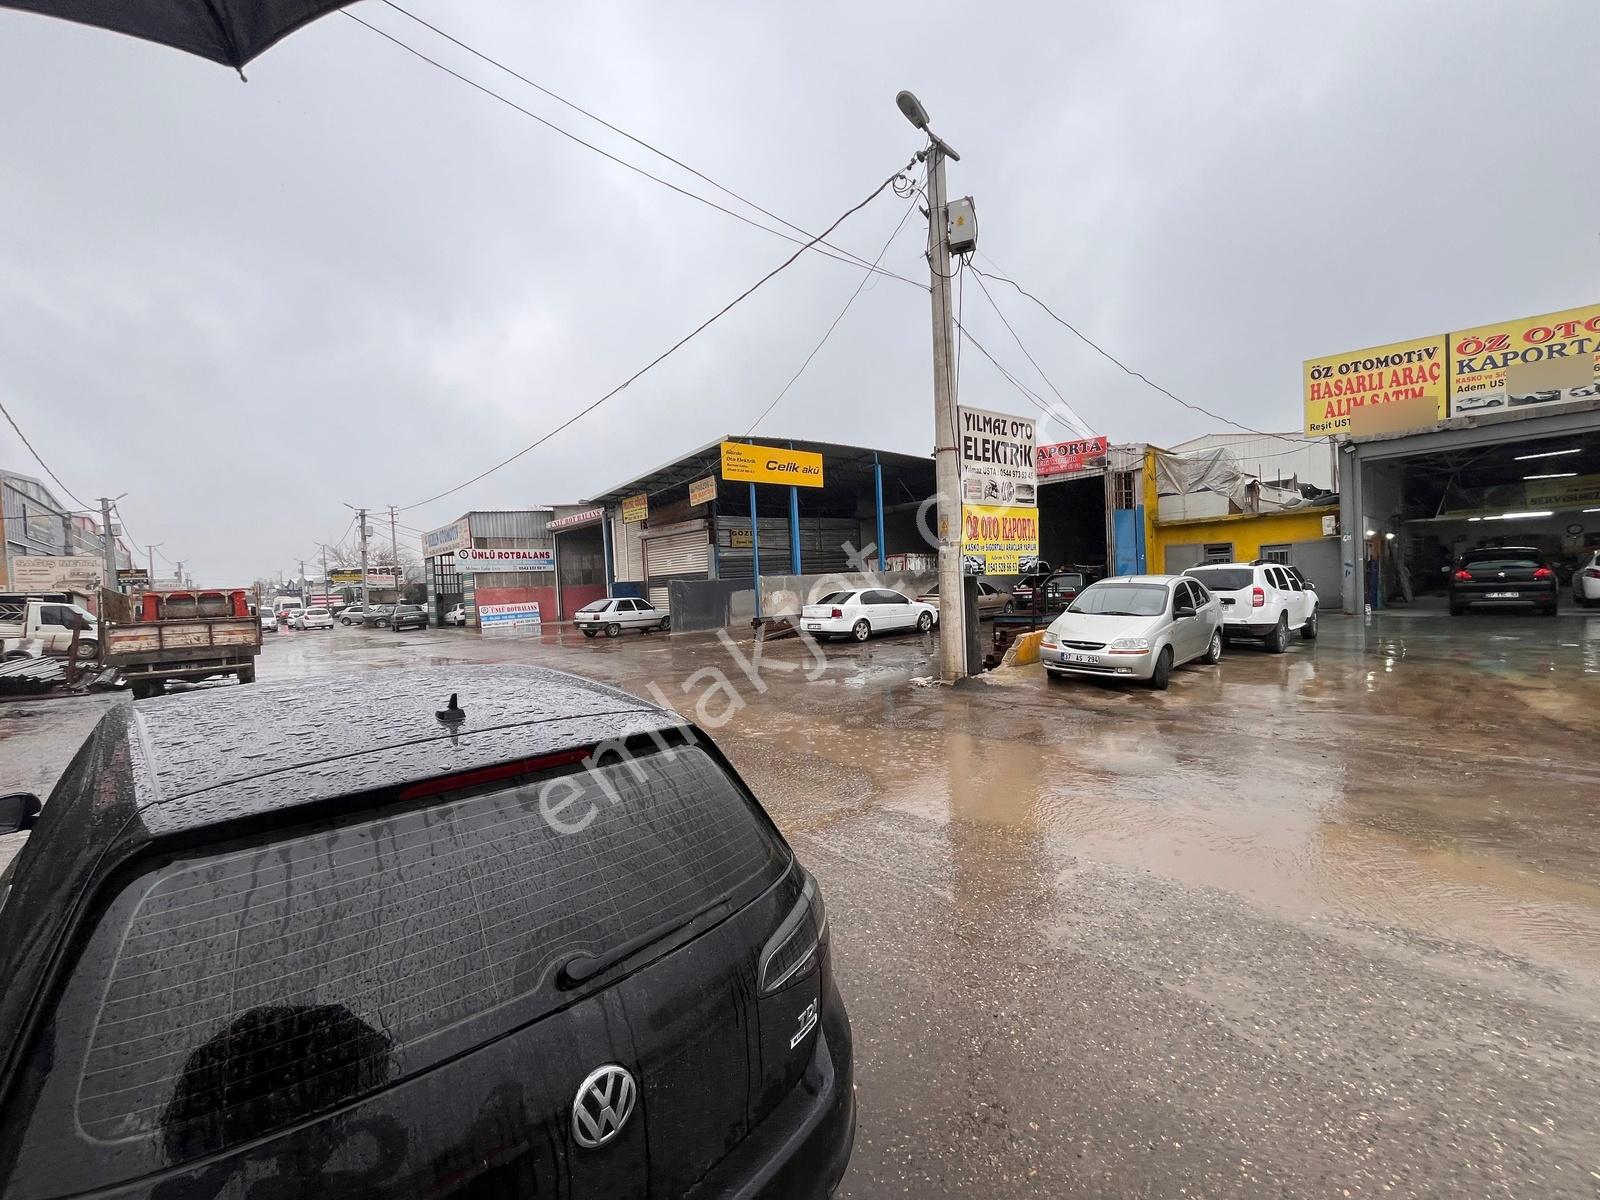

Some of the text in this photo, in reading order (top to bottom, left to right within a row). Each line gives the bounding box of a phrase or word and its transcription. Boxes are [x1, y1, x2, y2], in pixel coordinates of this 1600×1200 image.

[1456, 333, 1511, 356] ÖZ
[1310, 365, 1334, 380] ÖZ
[1310, 362, 1441, 400] HASARLI ARAÇ
[1457, 383, 1486, 393] Adem
[964, 412, 1033, 440] YILMAZ OTO
[1310, 421, 1332, 431] Reşit
[981, 516, 1000, 541] OTO
[1002, 517, 1037, 541] KAPORTA
[471, 550, 496, 560] ÜNLÜ
[497, 551, 551, 560] ROTBALANS
